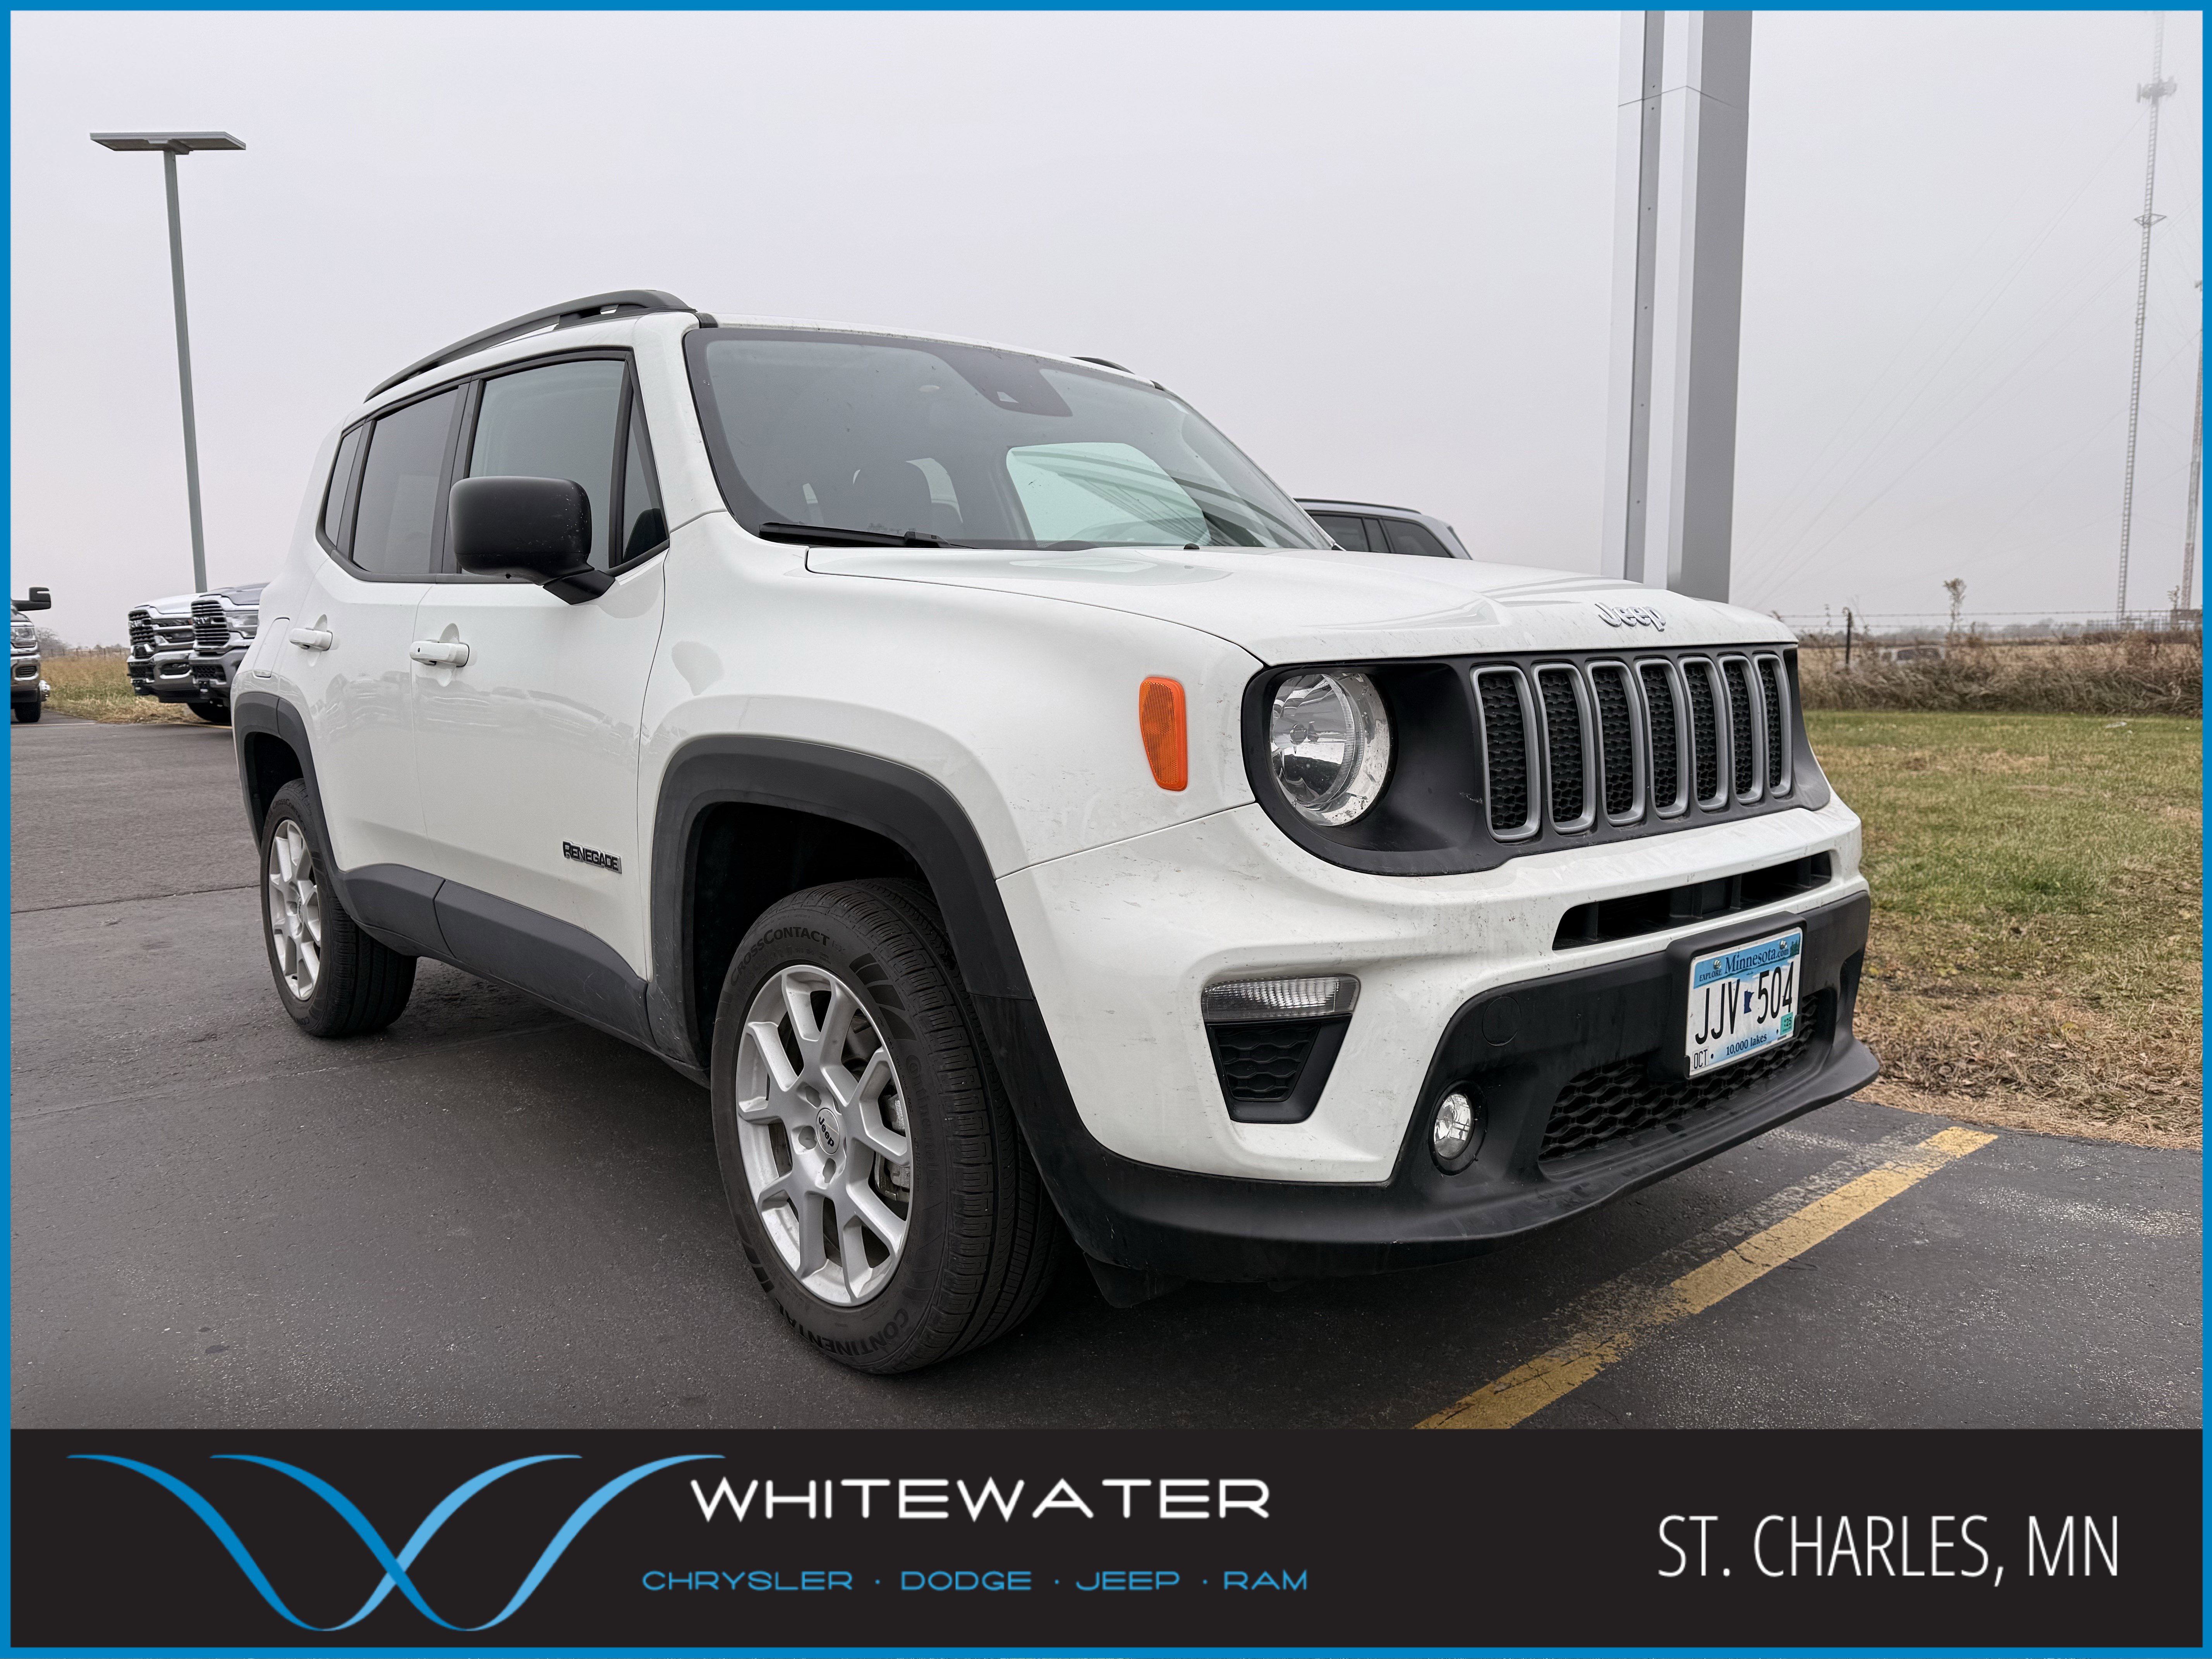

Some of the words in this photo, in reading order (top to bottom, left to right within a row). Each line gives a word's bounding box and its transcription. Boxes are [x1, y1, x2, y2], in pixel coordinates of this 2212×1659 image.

[1594, 602, 1666, 632] Jeep
[563, 840, 622, 874] RENEGADE
[1699, 969, 1722, 982] EXPLORE
[1695, 979, 1740, 1044] JJV
[1757, 961, 1794, 1024] 504
[1693, 1049, 1708, 1069] OCT
[1726, 1039, 1748, 1056] 10,000
[1750, 1033, 1767, 1047] lakes
[819, 1116, 835, 1147] Jeep
